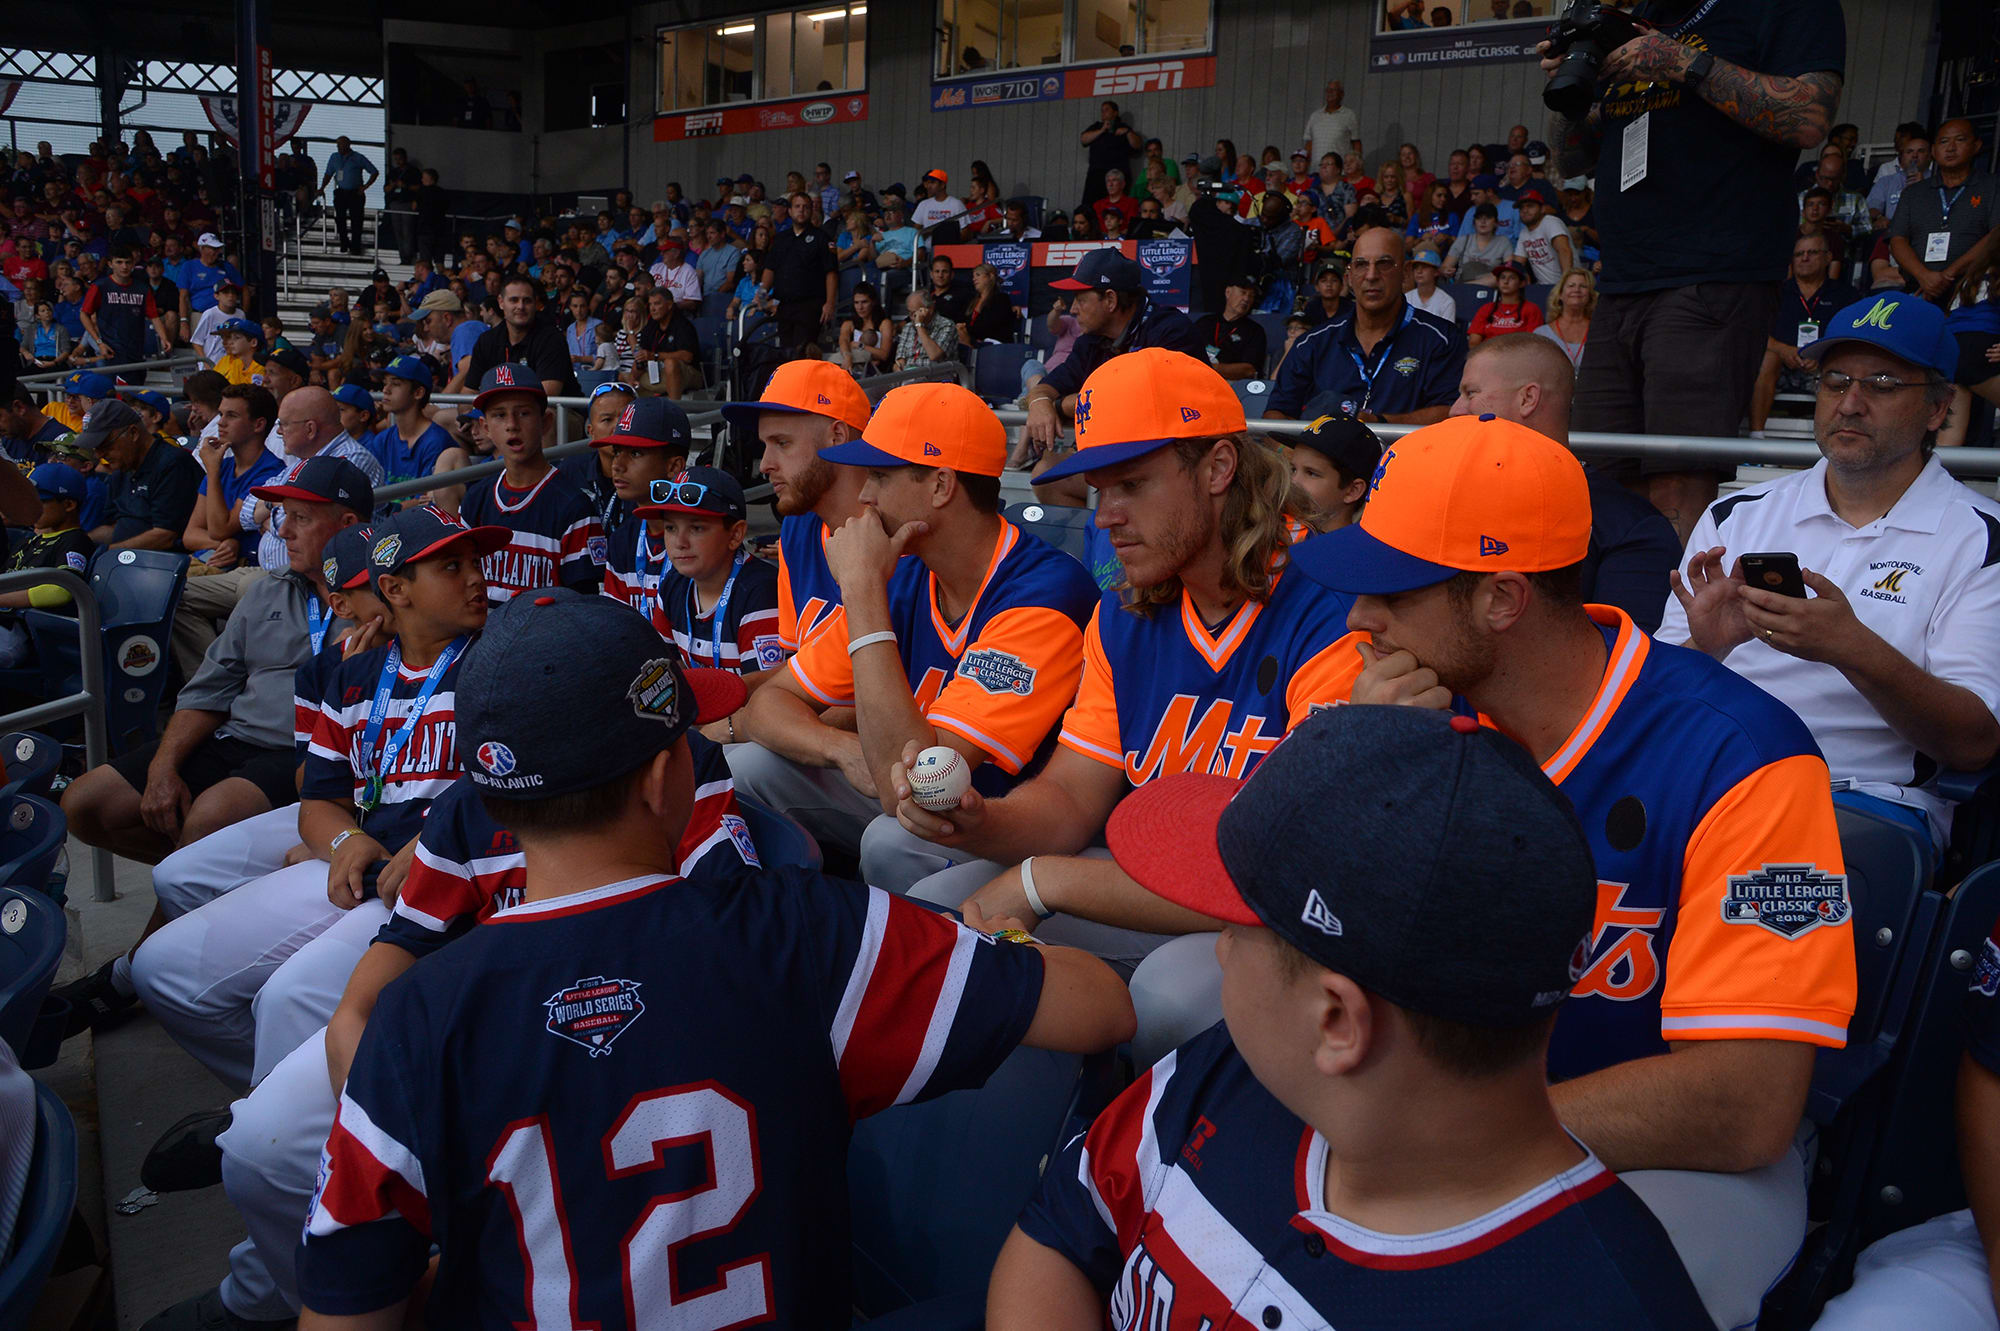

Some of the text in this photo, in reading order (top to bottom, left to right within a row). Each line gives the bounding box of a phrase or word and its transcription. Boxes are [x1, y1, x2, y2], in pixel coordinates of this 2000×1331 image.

[1407, 51, 1439, 63] LITTLE
[1440, 48, 1478, 61] LEAGUE
[1479, 45, 1520, 57] CLASSIC
[1092, 61, 1185, 96] ESPN
[975, 86, 1000, 97] WOR
[1005, 81, 1034, 98] 710
[261, 49, 272, 188] SECTION 4
[685, 111, 724, 131] ESPN
[1162, 247, 1186, 255] LEAGUE
[1852, 297, 1900, 330] M
[1874, 568, 1909, 593] M
[1860, 588, 1907, 605] BASEBALL
[968, 655, 1032, 681] LITTLE LEAGUE
[993, 656, 1010, 666] MLB
[979, 668, 1012, 685] CLASSIC
[470, 770, 544, 790] MID-ATLANTIC
[1775, 874, 1802, 884] MLB
[1735, 884, 1840, 898] LITTLE LEAGUE
[1761, 900, 1818, 913] CLASSIC
[1775, 914, 1806, 923] 2018
[566, 985, 618, 1001] LITTLE LEAGUE
[555, 993, 634, 1025] WORLD SERIES
[573, 1015, 620, 1030] BASEBALL
[484, 1077, 777, 1331] 12
